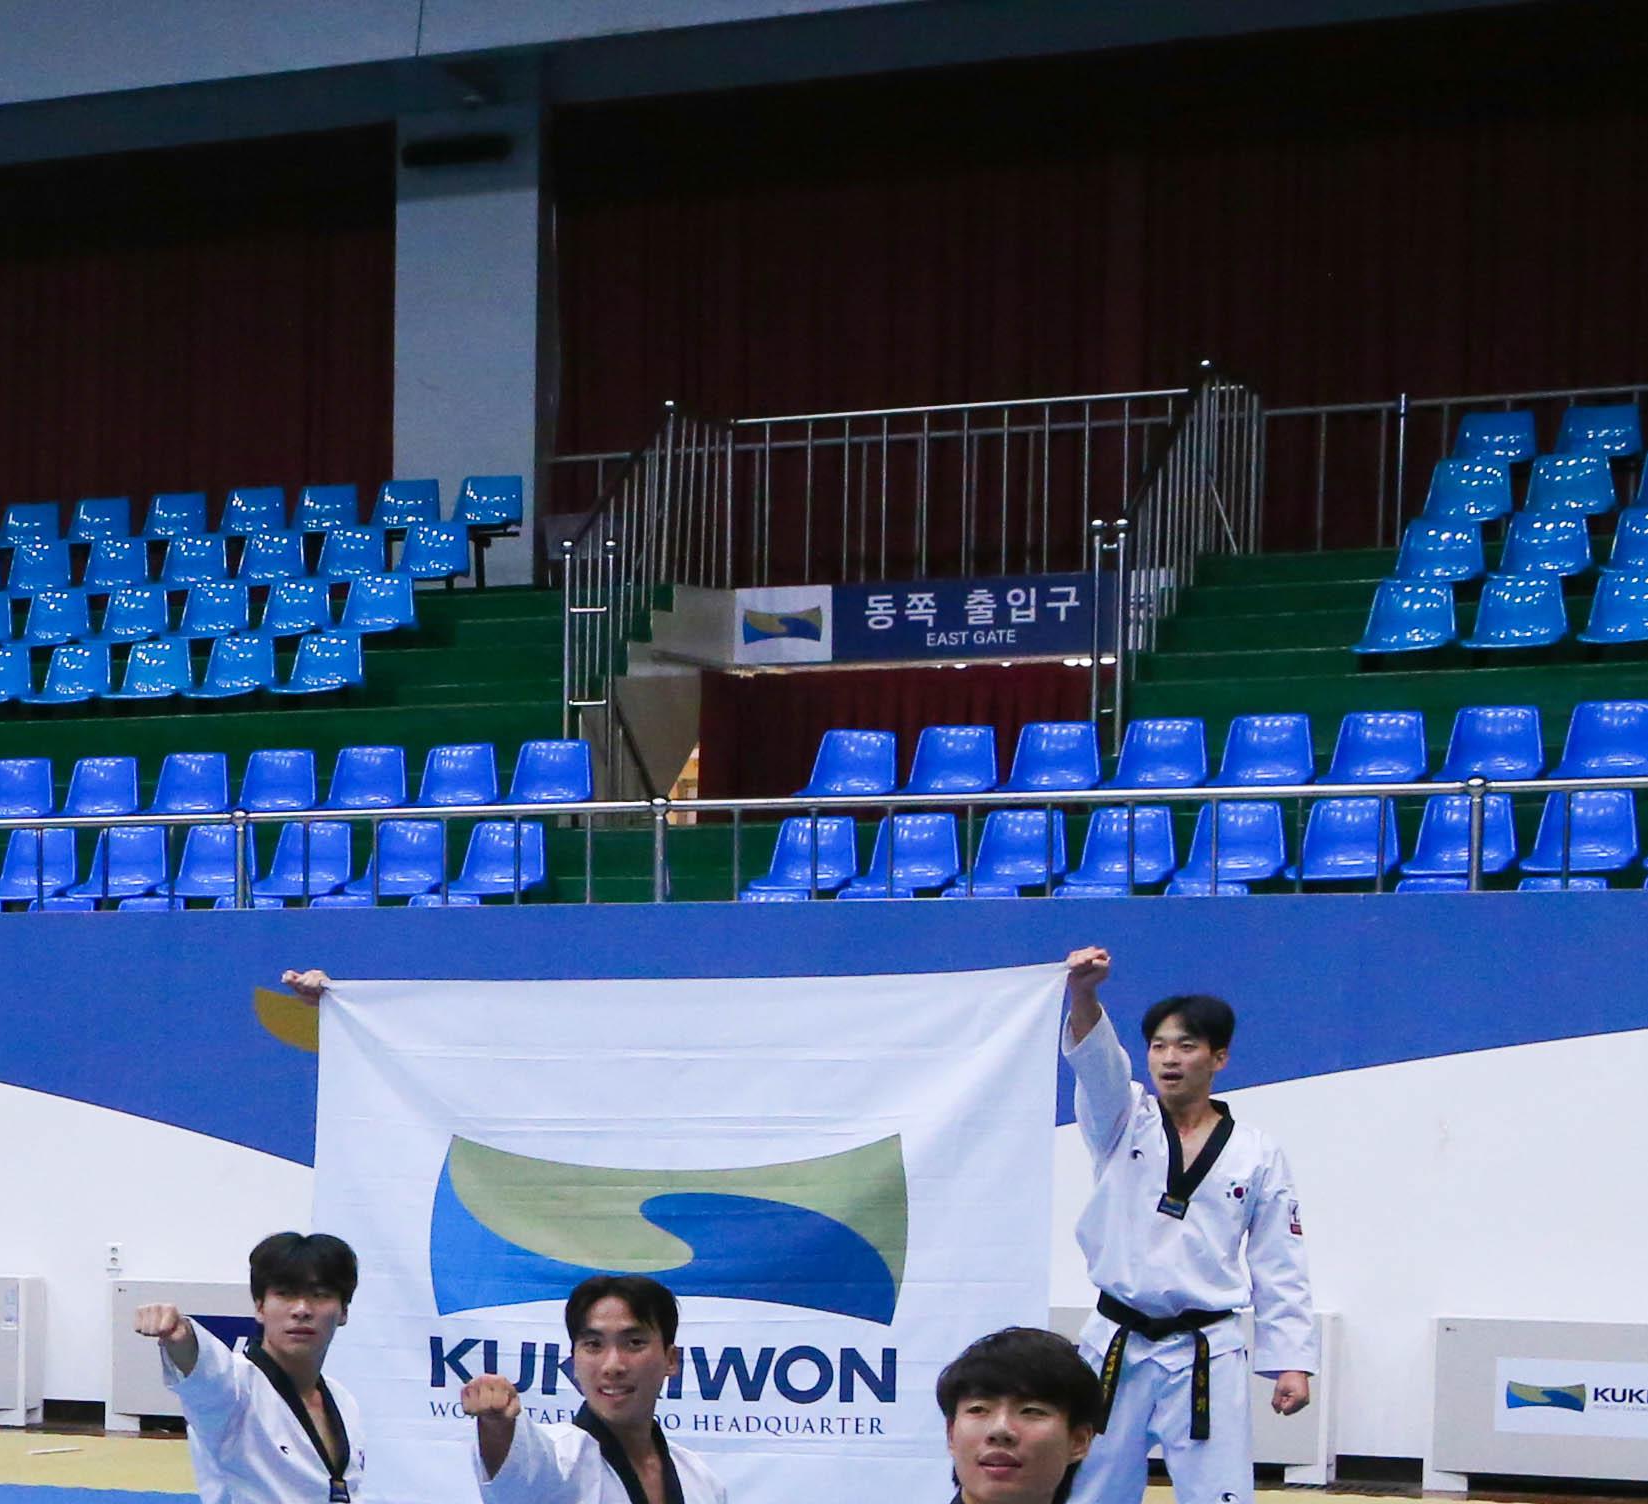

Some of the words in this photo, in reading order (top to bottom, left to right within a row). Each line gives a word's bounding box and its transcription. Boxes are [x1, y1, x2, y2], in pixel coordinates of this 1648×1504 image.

[864, 592, 938, 630] 동쪽
[963, 586, 1081, 626] 출입구
[926, 631, 969, 647] EAST
[973, 629, 1016, 645] GATE
[430, 1336, 898, 1404] KUKIWON
[693, 1414, 885, 1437] HEADQUARTER
